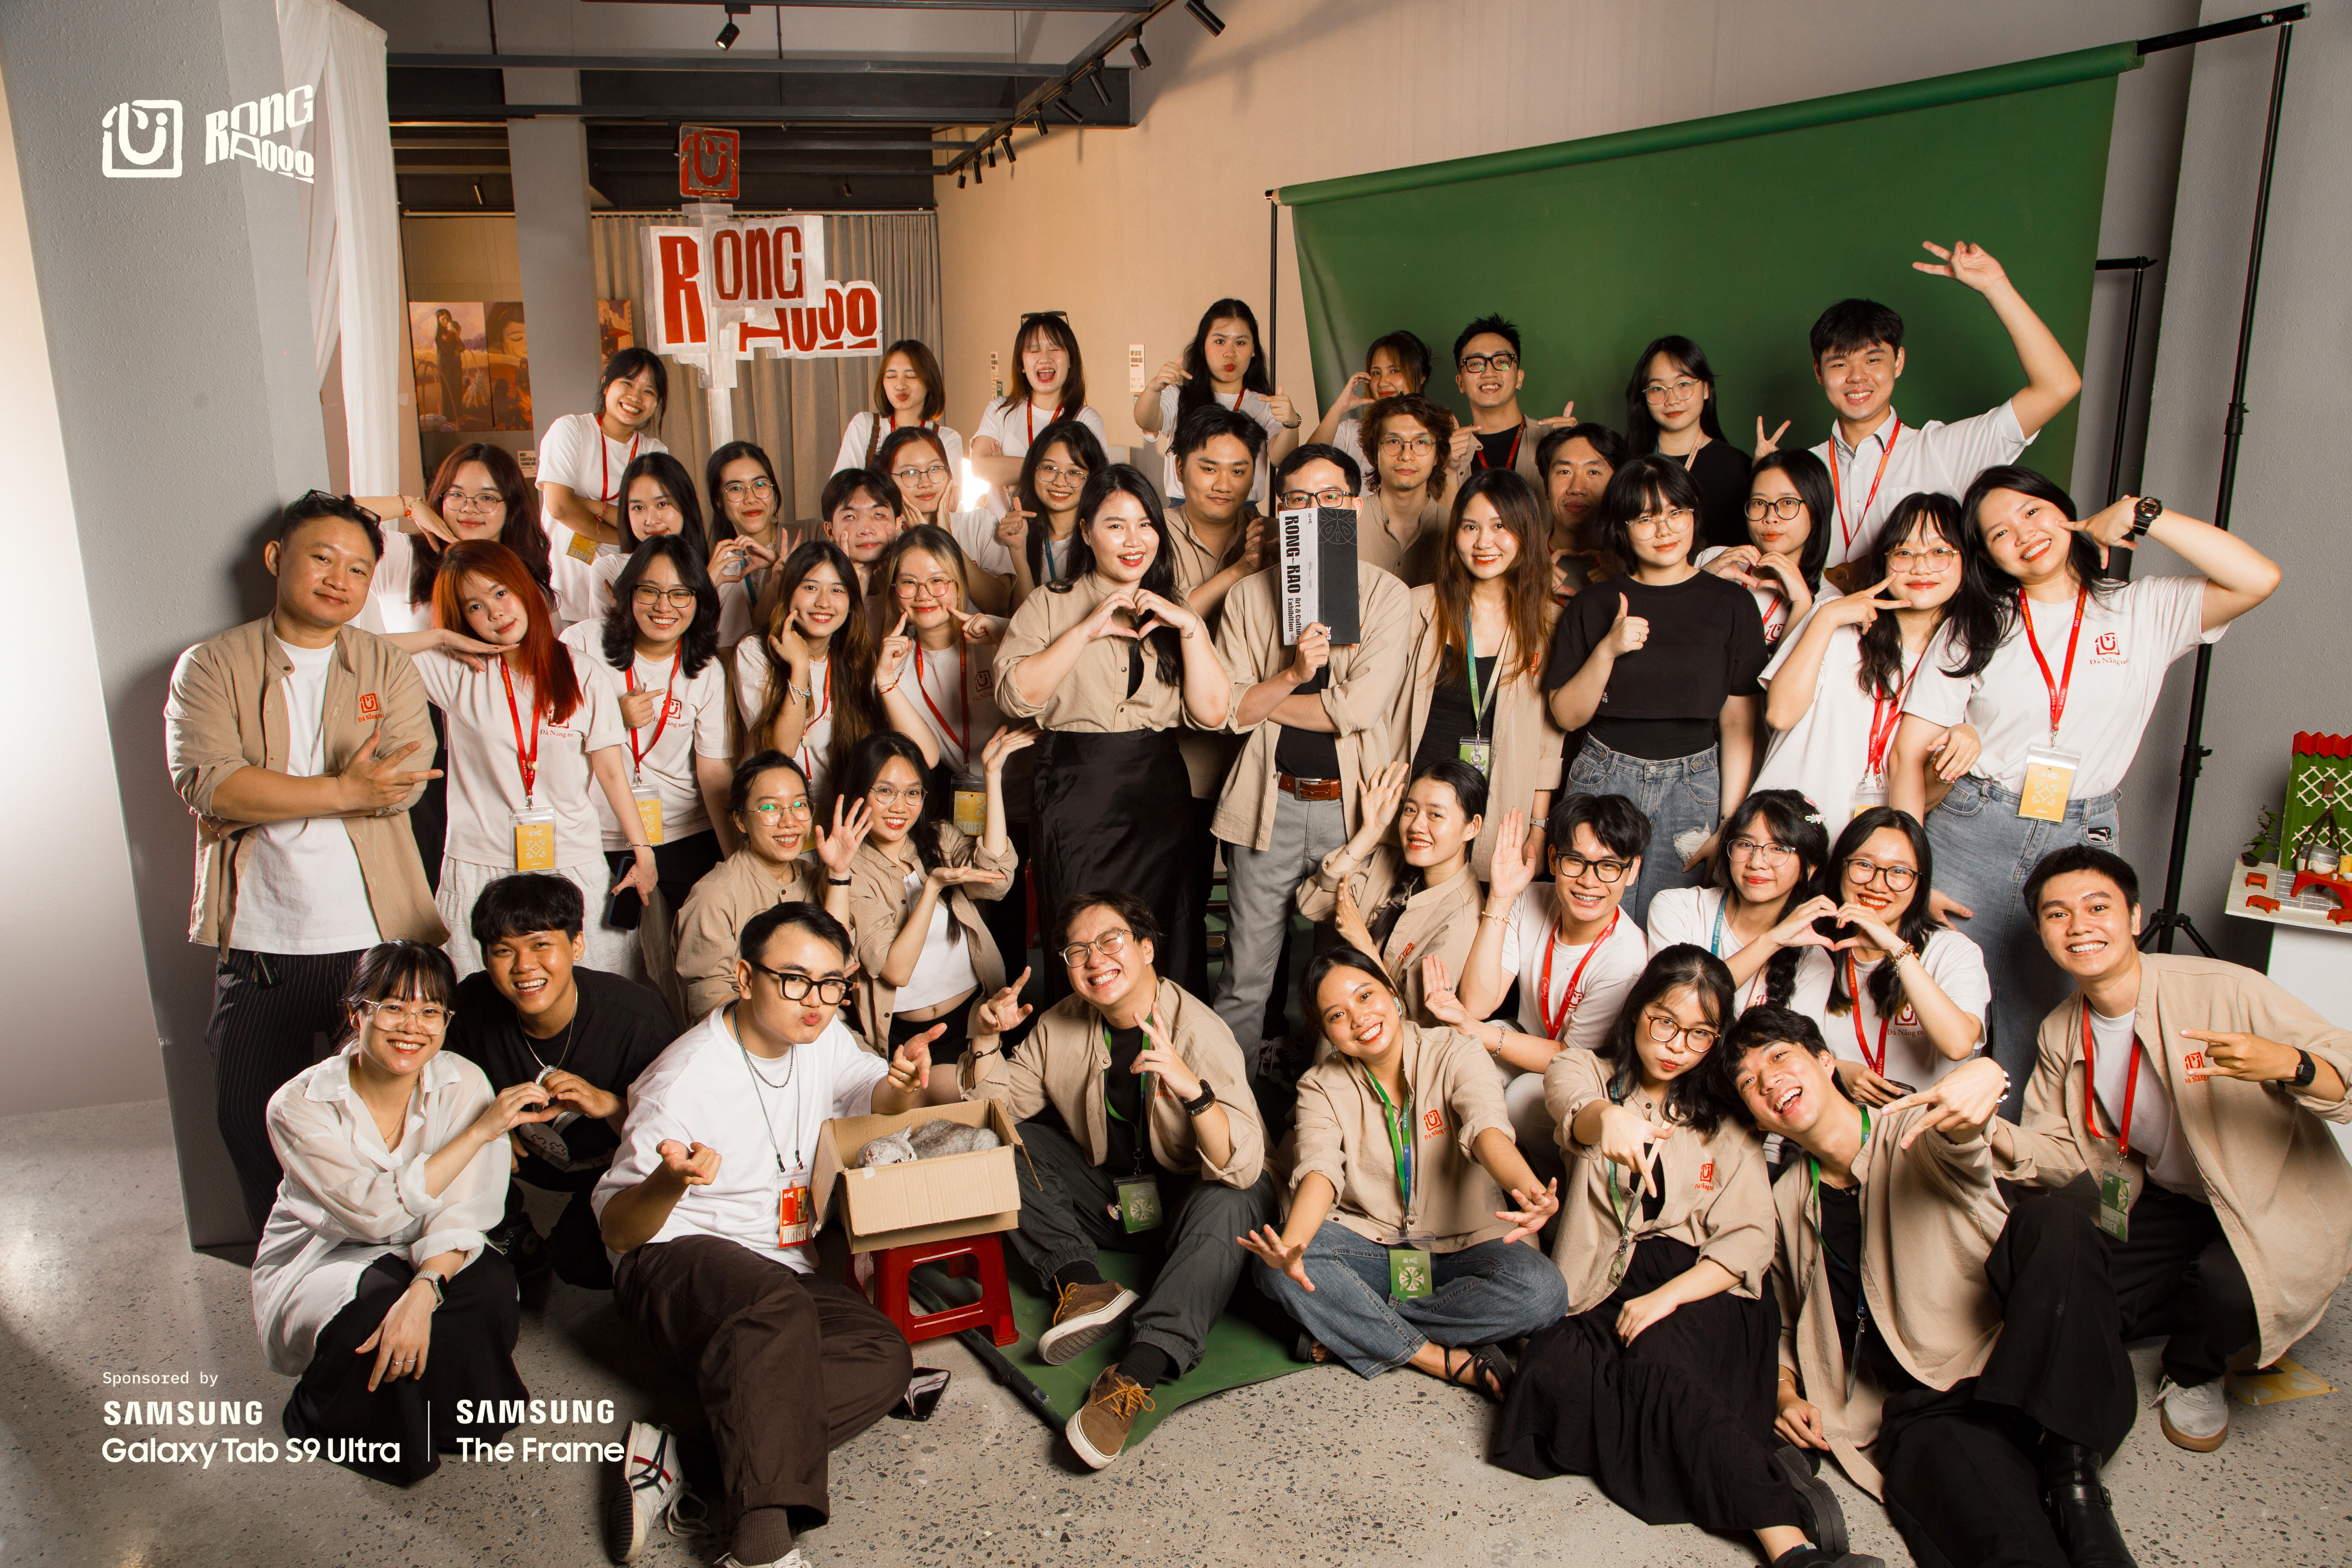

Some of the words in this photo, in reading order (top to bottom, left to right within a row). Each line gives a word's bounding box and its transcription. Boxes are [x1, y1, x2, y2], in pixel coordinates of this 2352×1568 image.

[570, 548, 593, 562] STAFF
[2102, 657, 2120, 666] Nẵng
[957, 821, 984, 834] STAFF
[1898, 1029, 1916, 1038] Nẵng
[782, 1226, 807, 1244] ARTIST
